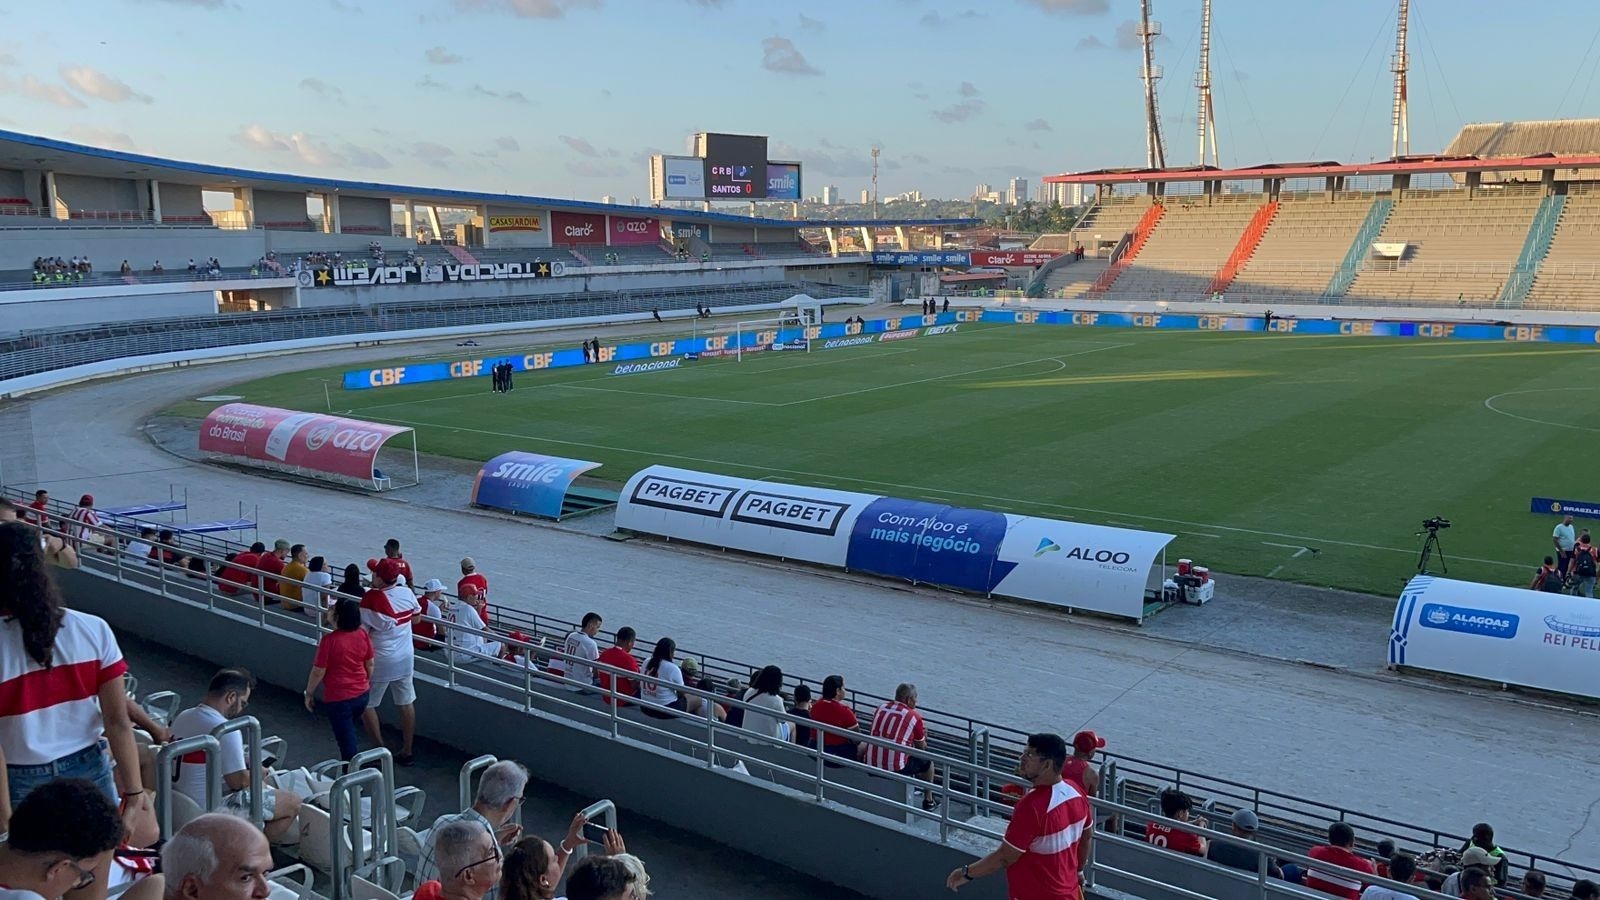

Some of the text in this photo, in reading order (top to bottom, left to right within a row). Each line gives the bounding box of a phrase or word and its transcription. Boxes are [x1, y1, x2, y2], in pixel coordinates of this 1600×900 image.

[712, 185, 741, 193] SANTOS
[768, 174, 795, 189] smile
[565, 225, 590, 237] Claro
[626, 221, 647, 232] azo
[678, 226, 702, 238] smile
[945, 253, 966, 263] smile
[988, 255, 1012, 265] Claro
[922, 314, 937, 326] CBF
[956, 311, 984, 323] CBF
[1014, 311, 1039, 324] CBF
[1072, 312, 1099, 325] CBF
[1133, 312, 1161, 328] CBF
[1198, 316, 1228, 330] CBF
[885, 319, 901, 331] CBF
[1268, 319, 1298, 332] CBF
[1340, 320, 1375, 335] CBF
[1419, 322, 1455, 337] CBF
[756, 330, 778, 345] CBF
[803, 326, 822, 340] CBF
[1503, 325, 1544, 341] CBF
[651, 341, 676, 357] CBF
[705, 335, 729, 351] CBF
[825, 335, 874, 349] betnacional
[450, 359, 483, 378] CBF
[523, 352, 553, 370] CBF
[614, 357, 681, 375] betnacional
[369, 367, 405, 387] CBF
[209, 424, 247, 442] do Brasil
[333, 428, 382, 452] azo
[491, 460, 563, 484] smile
[646, 481, 723, 506] PAGBET
[746, 498, 831, 523] PAGBET
[1563, 506, 1600, 515] BRASILE
[878, 512, 969, 534] Com Aloo é
[870, 528, 980, 554] mais negócio
[1066, 546, 1130, 565] ALOO
[1099, 563, 1137, 573] TELECOM
[1452, 613, 1510, 628] ALAGOAS
[1543, 632, 1567, 646] REI
[872, 710, 902, 739] 10
[1149, 833, 1168, 848] 10
